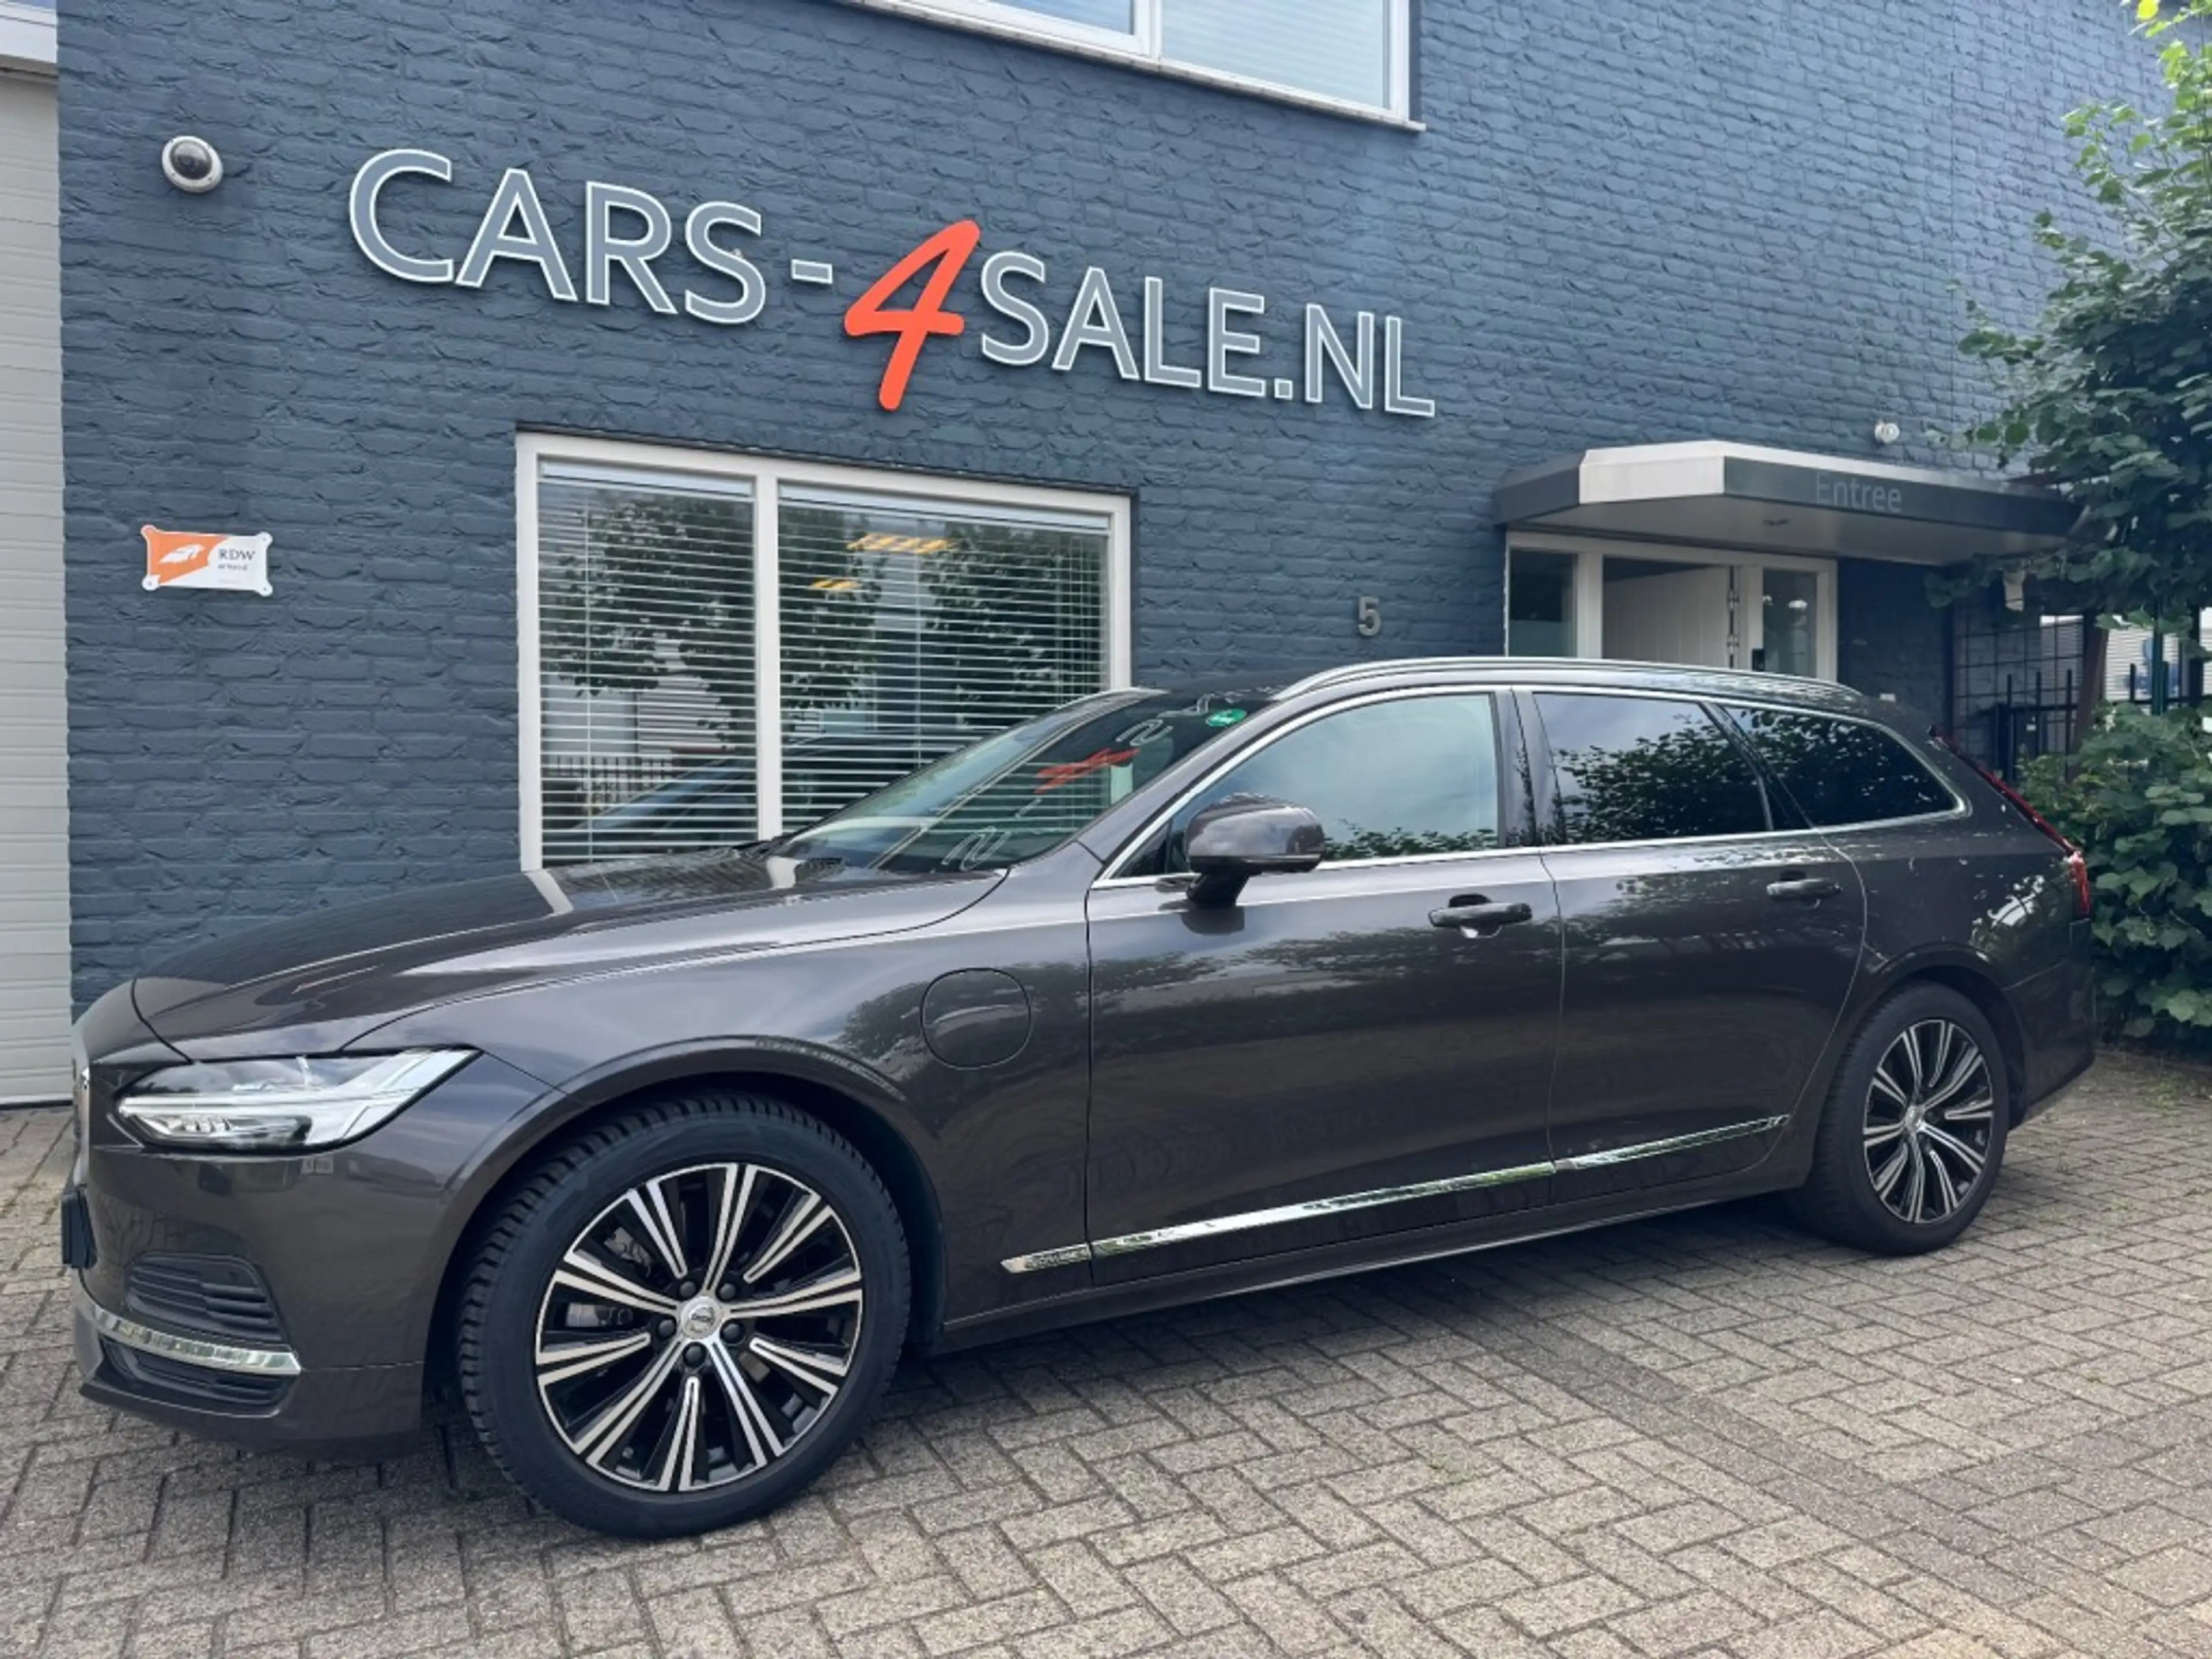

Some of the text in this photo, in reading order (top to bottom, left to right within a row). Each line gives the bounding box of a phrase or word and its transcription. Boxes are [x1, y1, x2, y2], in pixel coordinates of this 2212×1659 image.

[1816, 472, 1902, 513] Entree
[218, 548, 255, 561] RDW
[1358, 596, 1381, 636] 5
